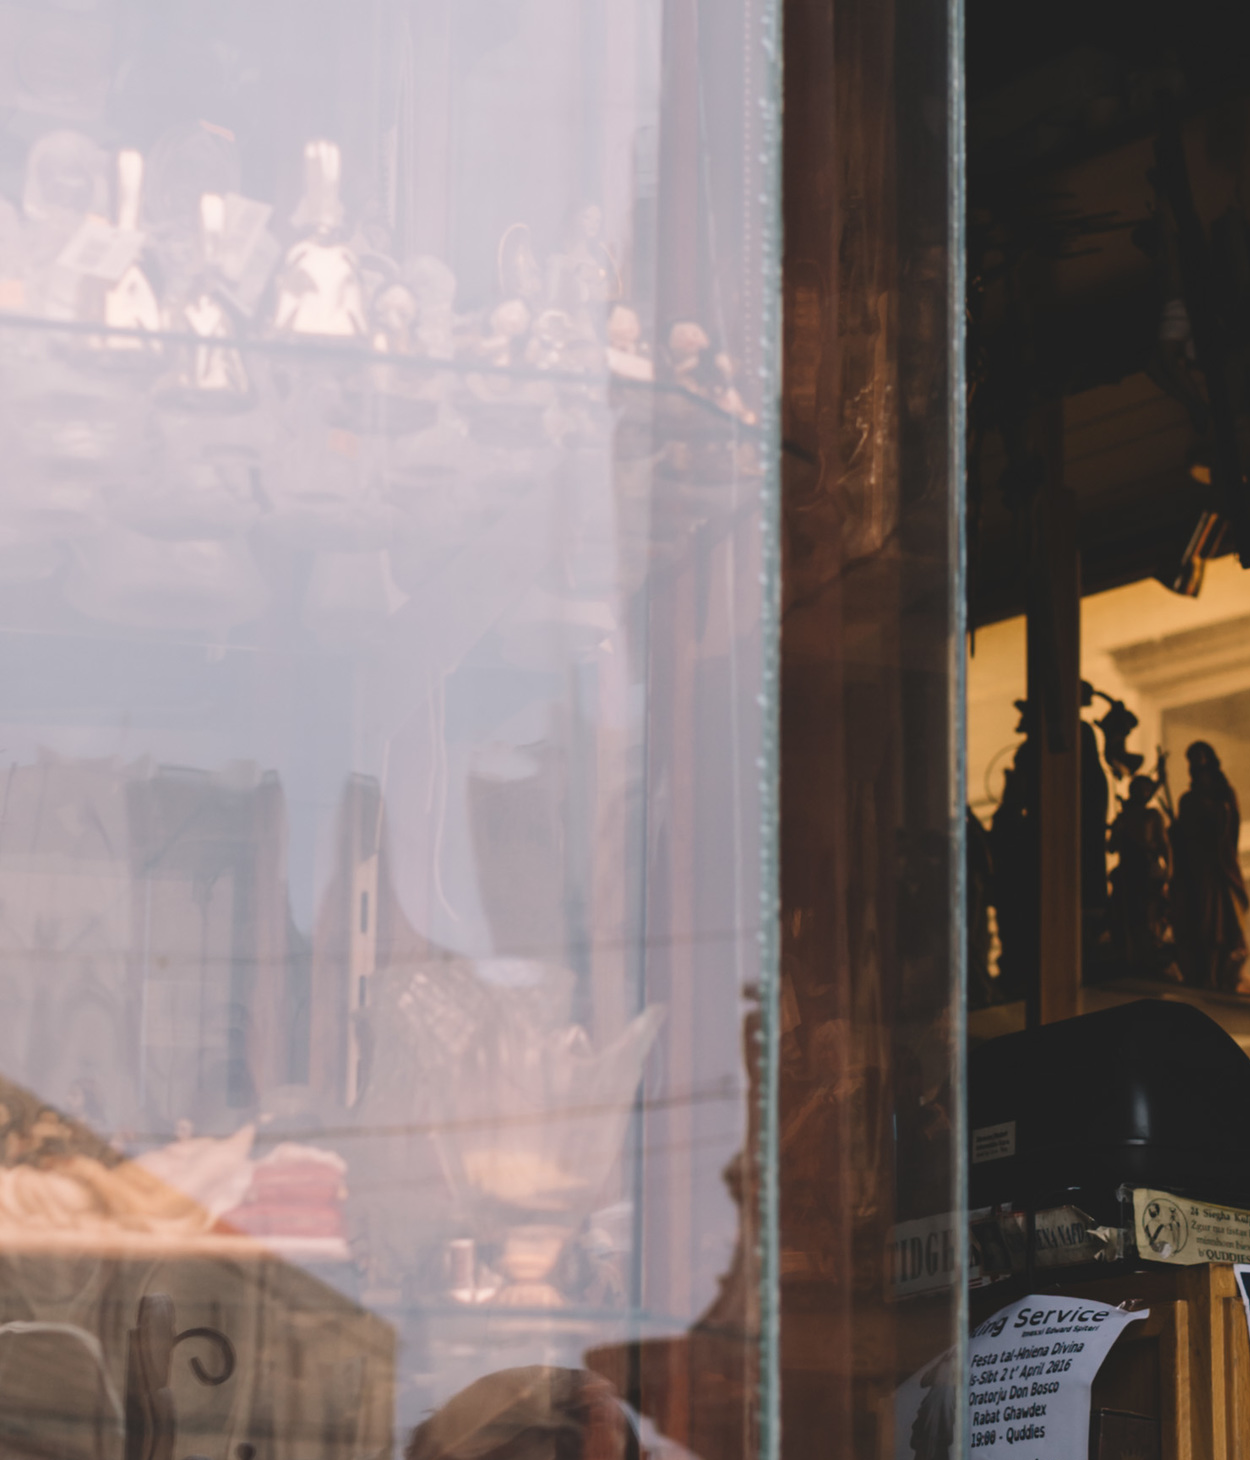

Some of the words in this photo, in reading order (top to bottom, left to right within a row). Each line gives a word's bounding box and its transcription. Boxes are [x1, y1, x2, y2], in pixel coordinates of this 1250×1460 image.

[1058, 1221, 1085, 1246] NAFD
[1013, 1306, 1110, 1328] Service
[1045, 1325, 1072, 1336] Edward
[1073, 1324, 1100, 1334] Spiteri
[971, 1353, 996, 1369] Festa
[1051, 1341, 1084, 1356] Divina
[999, 1368, 1008, 1381] 2
[1019, 1363, 1044, 1380] April
[1045, 1358, 1073, 1374] 2016
[969, 1387, 1007, 1407] Oratorju
[1009, 1384, 1028, 1399] Don
[1030, 1380, 1060, 1397] Bosco
[973, 1409, 1000, 1427] Rabat
[971, 1430, 996, 1448] 19:00
[1006, 1424, 1046, 1445] Quddies
